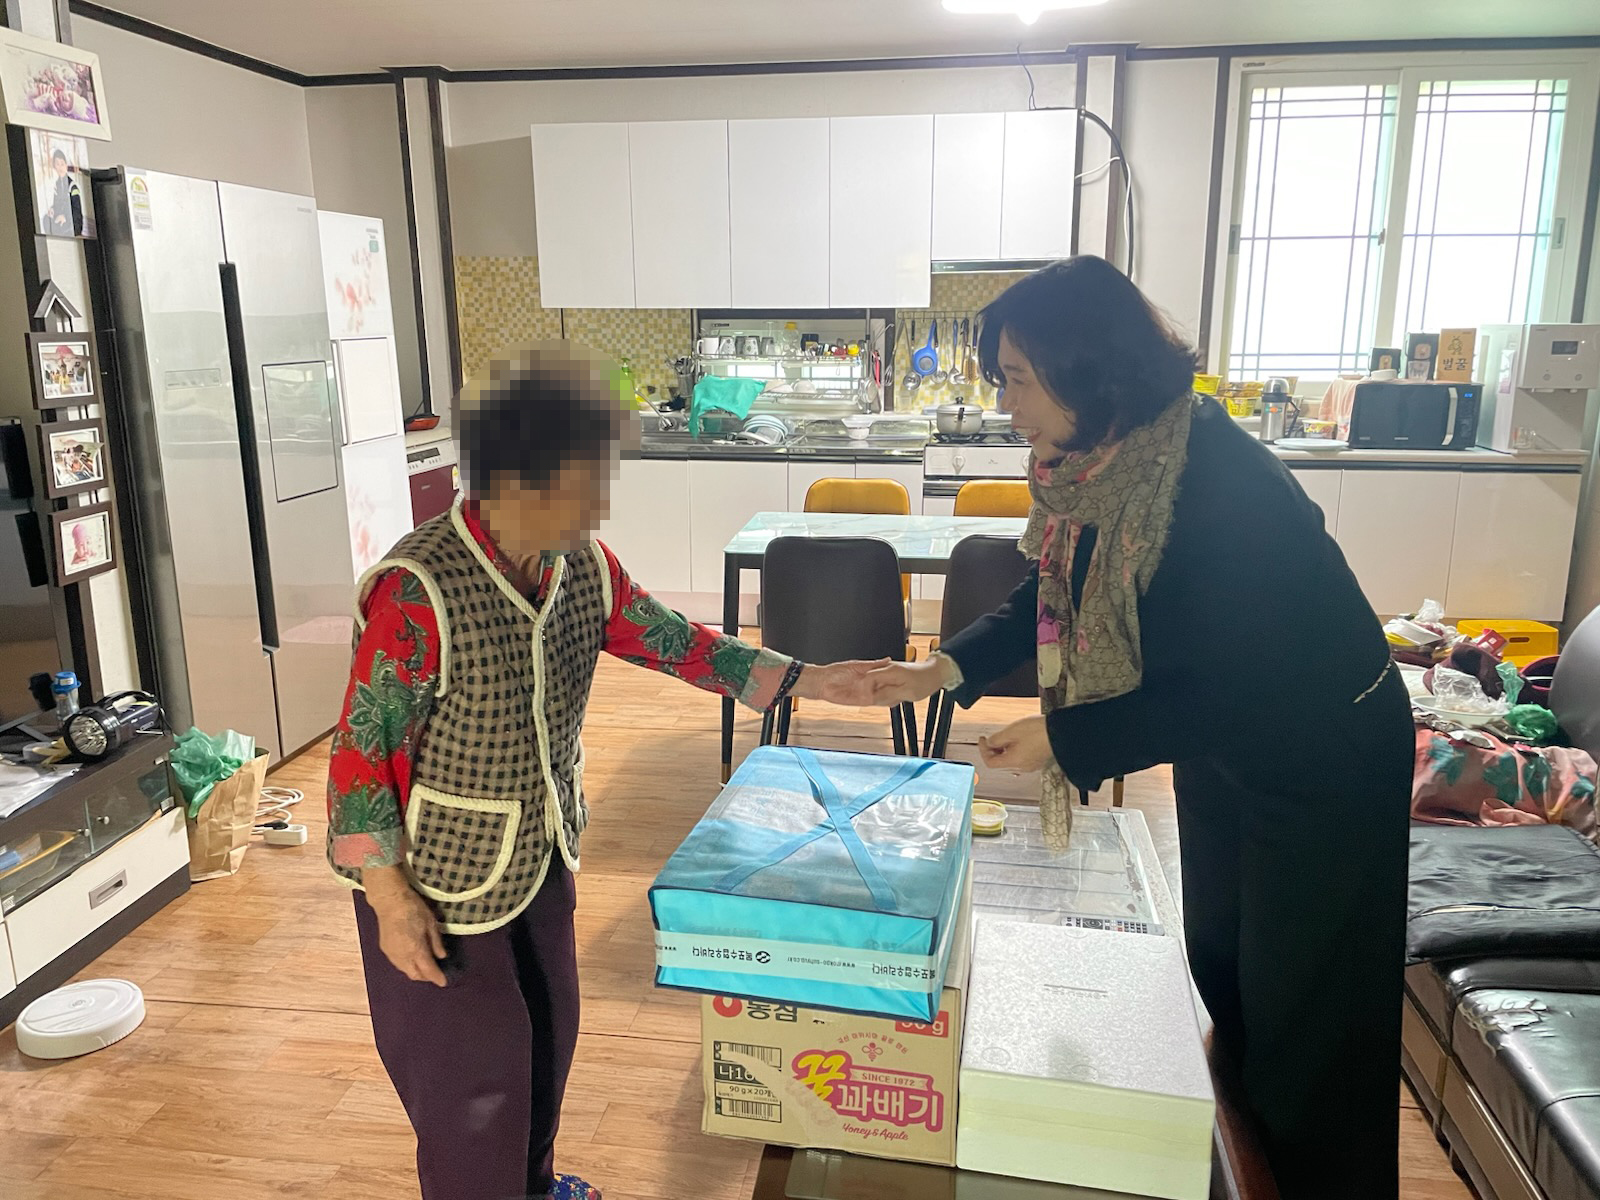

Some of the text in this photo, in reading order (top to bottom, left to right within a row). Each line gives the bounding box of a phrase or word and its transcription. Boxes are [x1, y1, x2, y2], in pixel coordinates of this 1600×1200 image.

[1442, 357, 1468, 371] 벌꿀
[861, 1072, 916, 1087] SINCE 1972
